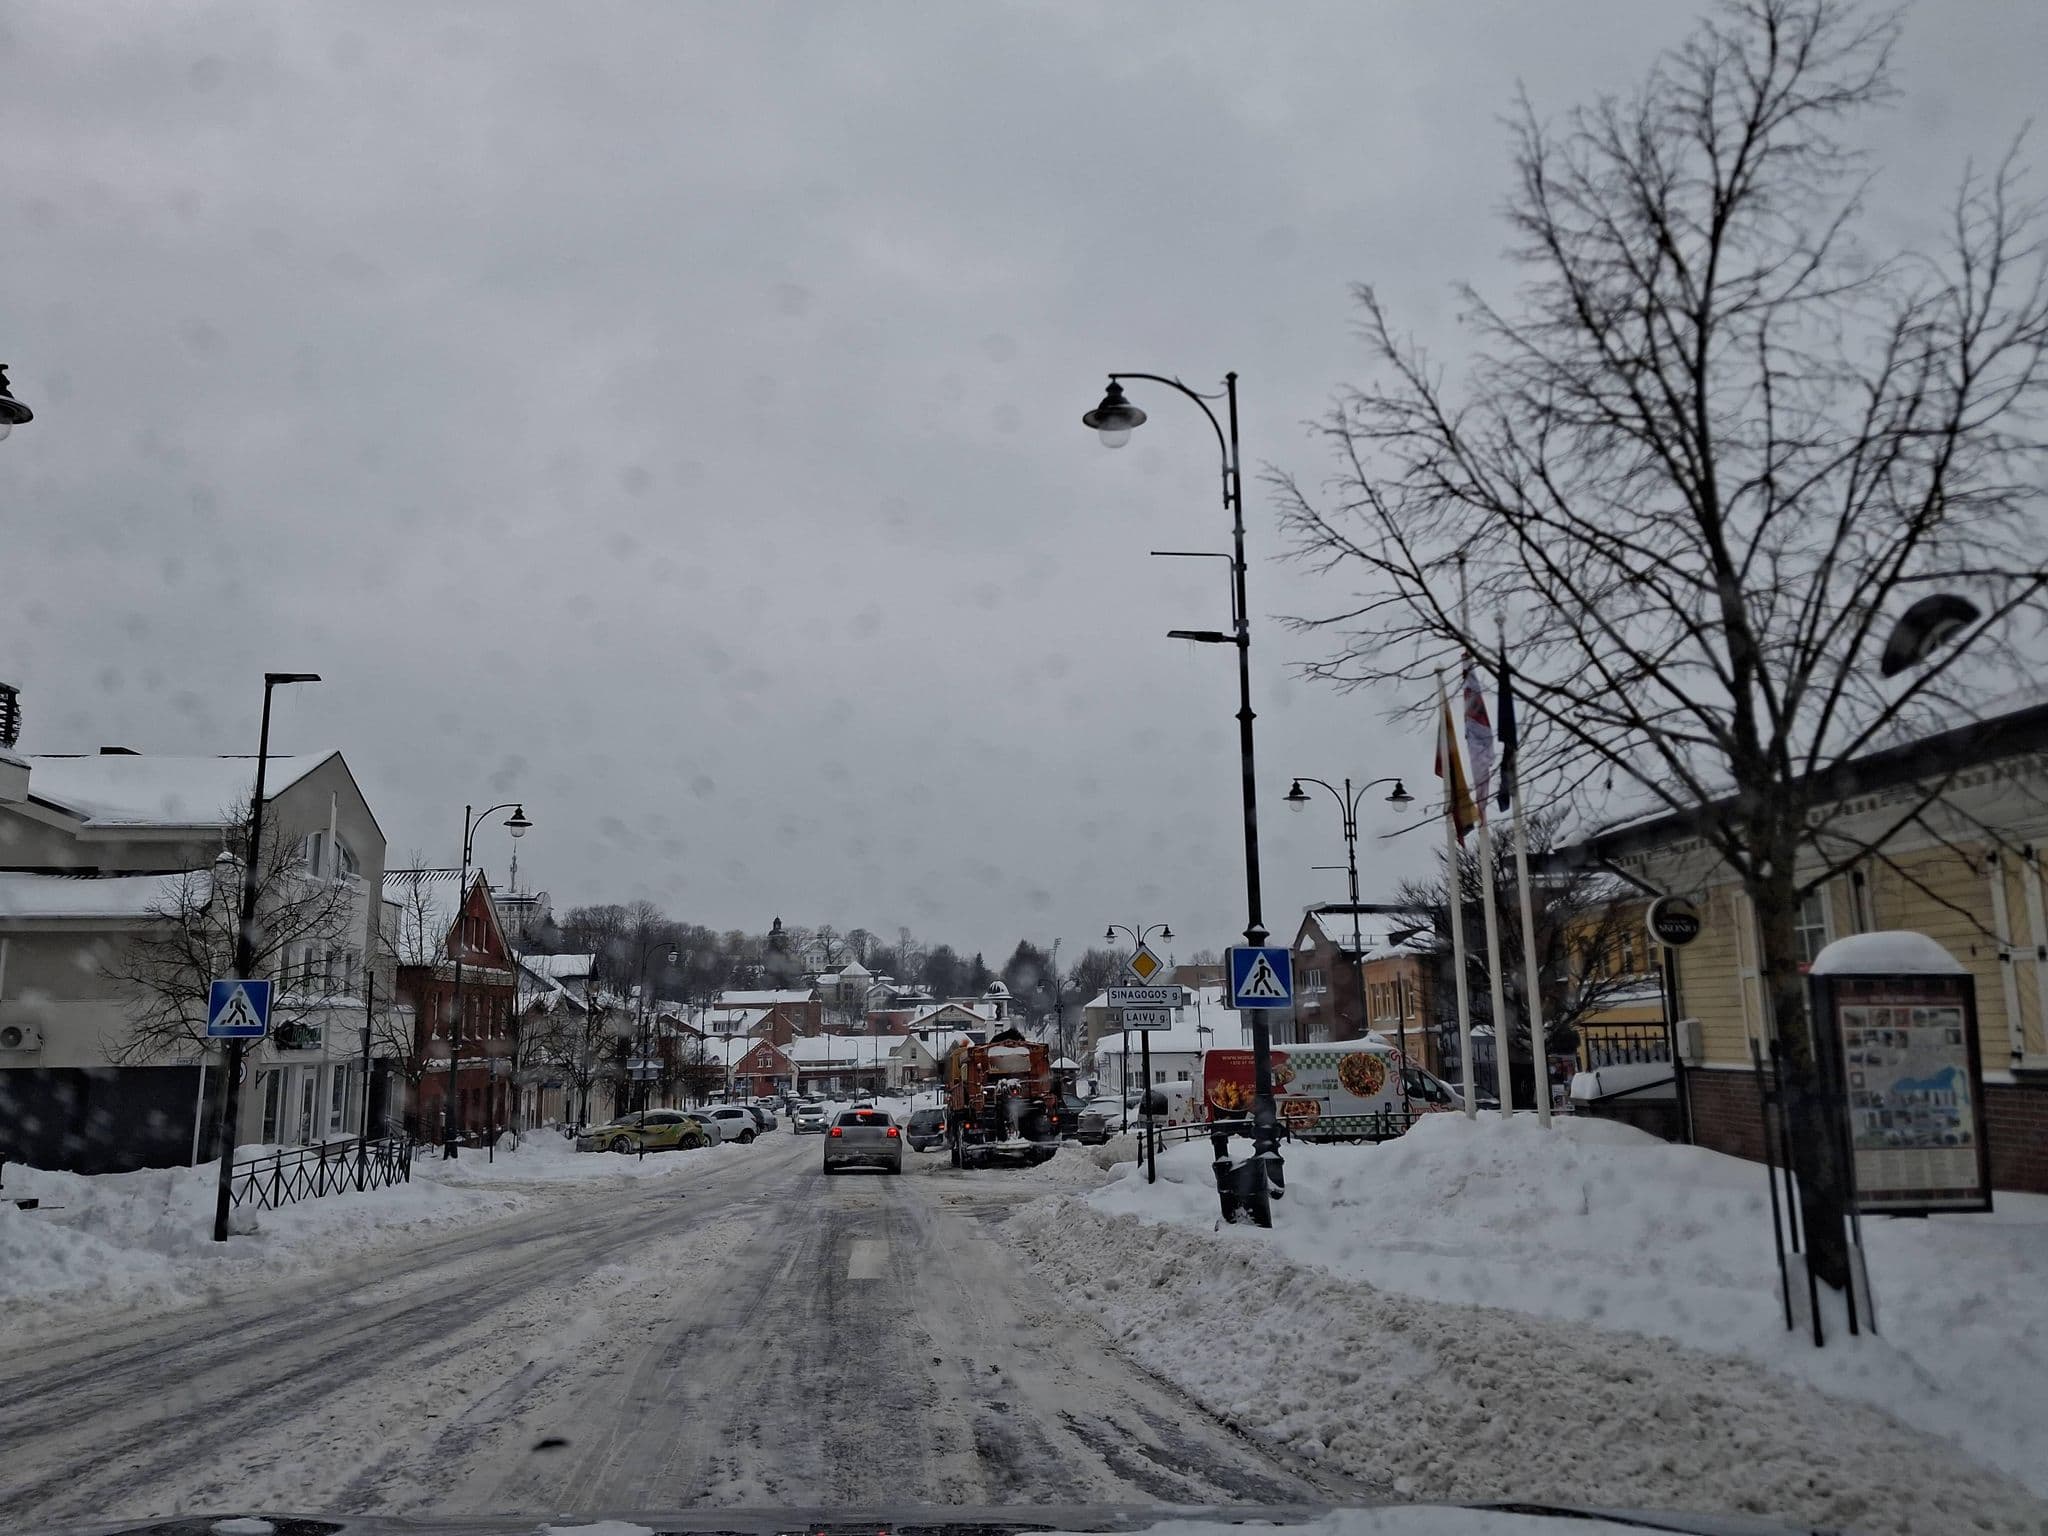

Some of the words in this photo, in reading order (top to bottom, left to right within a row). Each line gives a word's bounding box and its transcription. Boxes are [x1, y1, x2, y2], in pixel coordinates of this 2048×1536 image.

[1111, 990, 1168, 999] SINAGOGOS
[1172, 992, 1181, 1001] g.
[1126, 1012, 1155, 1024] LAIVŲ
[1160, 1014, 1169, 1024] g.
